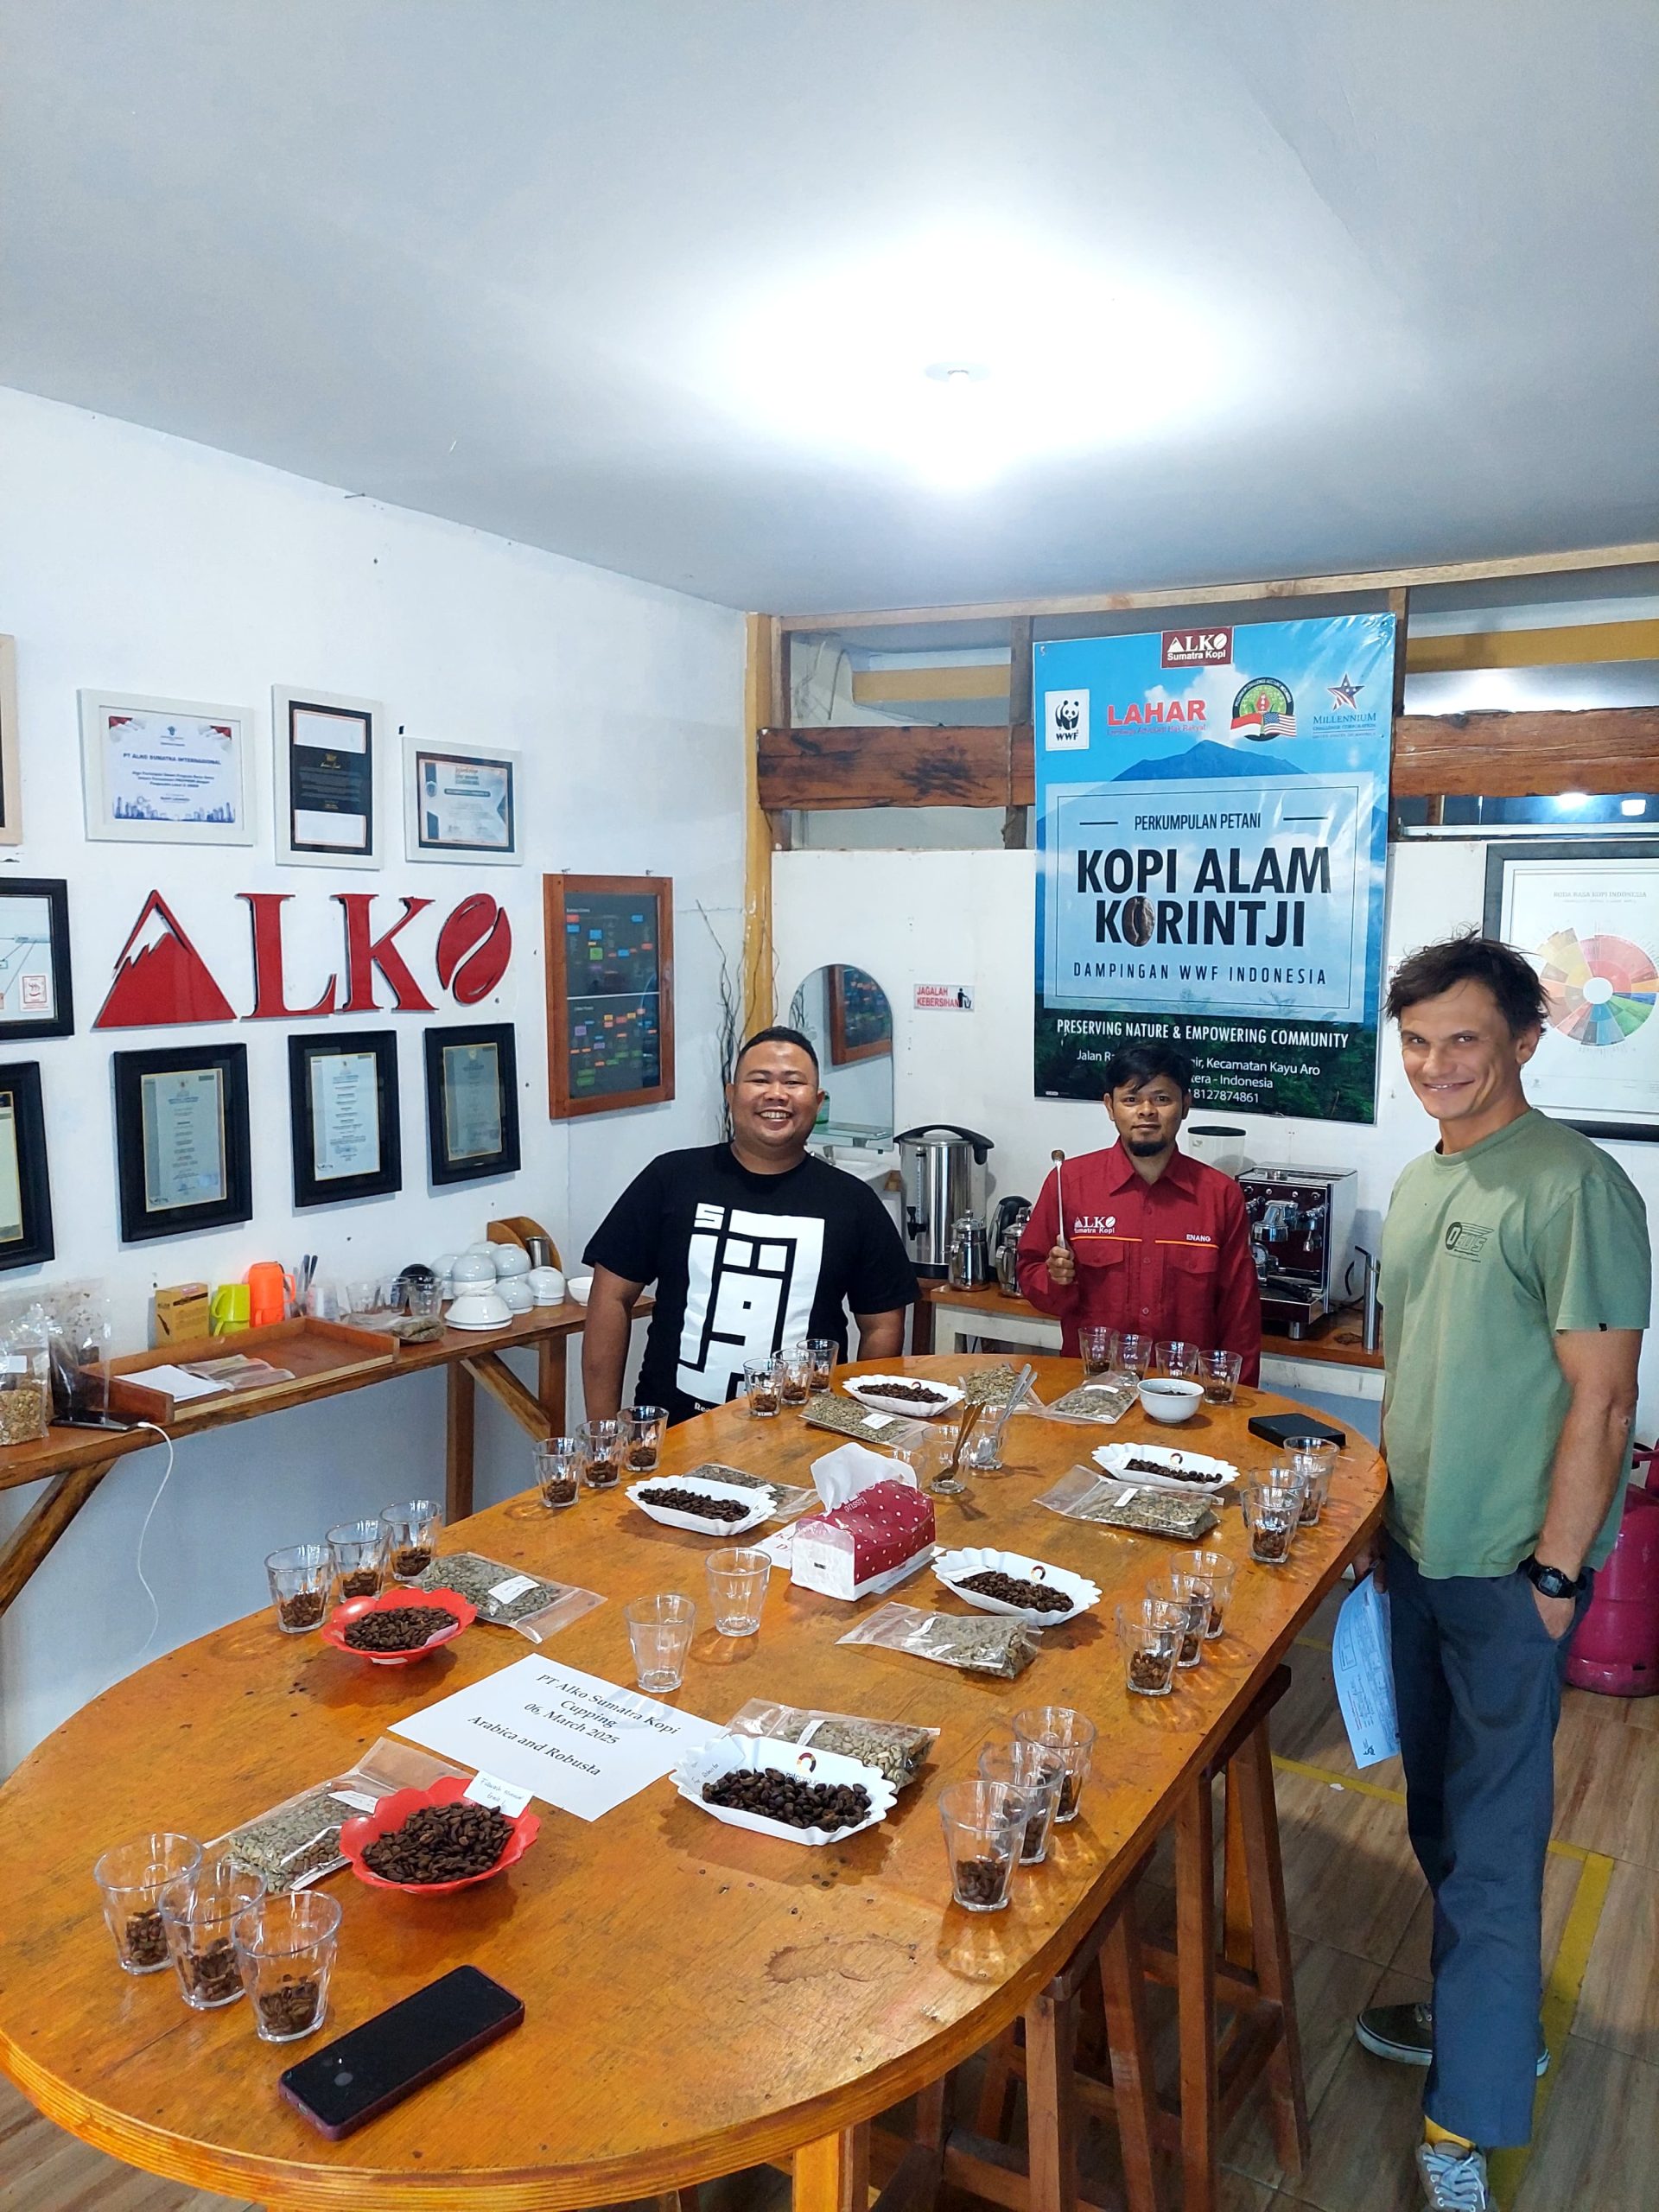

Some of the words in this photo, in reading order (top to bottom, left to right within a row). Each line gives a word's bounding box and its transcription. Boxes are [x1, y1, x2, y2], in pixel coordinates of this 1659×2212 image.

[1167, 632, 1227, 652] ALKO
[1167, 652, 1204, 661] Sumatra
[1205, 650, 1226, 659] Kopi
[1108, 700, 1206, 725] LAHAR
[1313, 713, 1376, 724] MILLENNIUM
[1056, 729, 1079, 741] WWF
[1135, 814, 1217, 830] PERKUMPULAN
[1220, 813, 1261, 830] PETANI
[1077, 849, 1178, 893] KOPI
[1193, 847, 1331, 893] ALAM
[1096, 895, 1305, 947] KORINTJI
[92, 889, 512, 1030] ALKO
[1074, 962, 1168, 979] DAMPINGAN
[1179, 965, 1218, 981] WWF
[1229, 966, 1326, 985] INDONESIA
[917, 986, 948, 996] JAGALAH
[917, 997, 960, 1007] KEBERSIHAN
[1058, 1019, 1122, 1036] PRESERVING
[1126, 1022, 1168, 1039] NATURE
[1173, 1026, 1181, 1039] &
[1185, 1026, 1266, 1044] EMPOWERING
[1271, 1030, 1349, 1049] COMMUNITY
[1077, 1049, 1103, 1062] Jalan
[1206, 1058, 1267, 1071] Kecamatan
[1270, 1062, 1298, 1076] Kayu
[1300, 1063, 1320, 1076] Aro
[1220, 1074, 1273, 1089] Indonesia
[1188, 1088, 1258, 1103] 8127874861
[1074, 1216, 1116, 1228] ALKO
[1186, 1234, 1211, 1243] ENANG
[537, 1675, 559, 1685] PT
[555, 1682, 588, 1698] Alko
[588, 1694, 643, 1719] Sumatra
[644, 1715, 682, 1736] Kopi
[560, 1700, 619, 1728] Cupping
[524, 1703, 541, 1715] 06,
[543, 1711, 586, 1732] March
[586, 1728, 620, 1745] 2025
[467, 1715, 518, 1740] Arabica
[518, 1735, 549, 1751] and
[544, 1747, 601, 1776] Robusta
